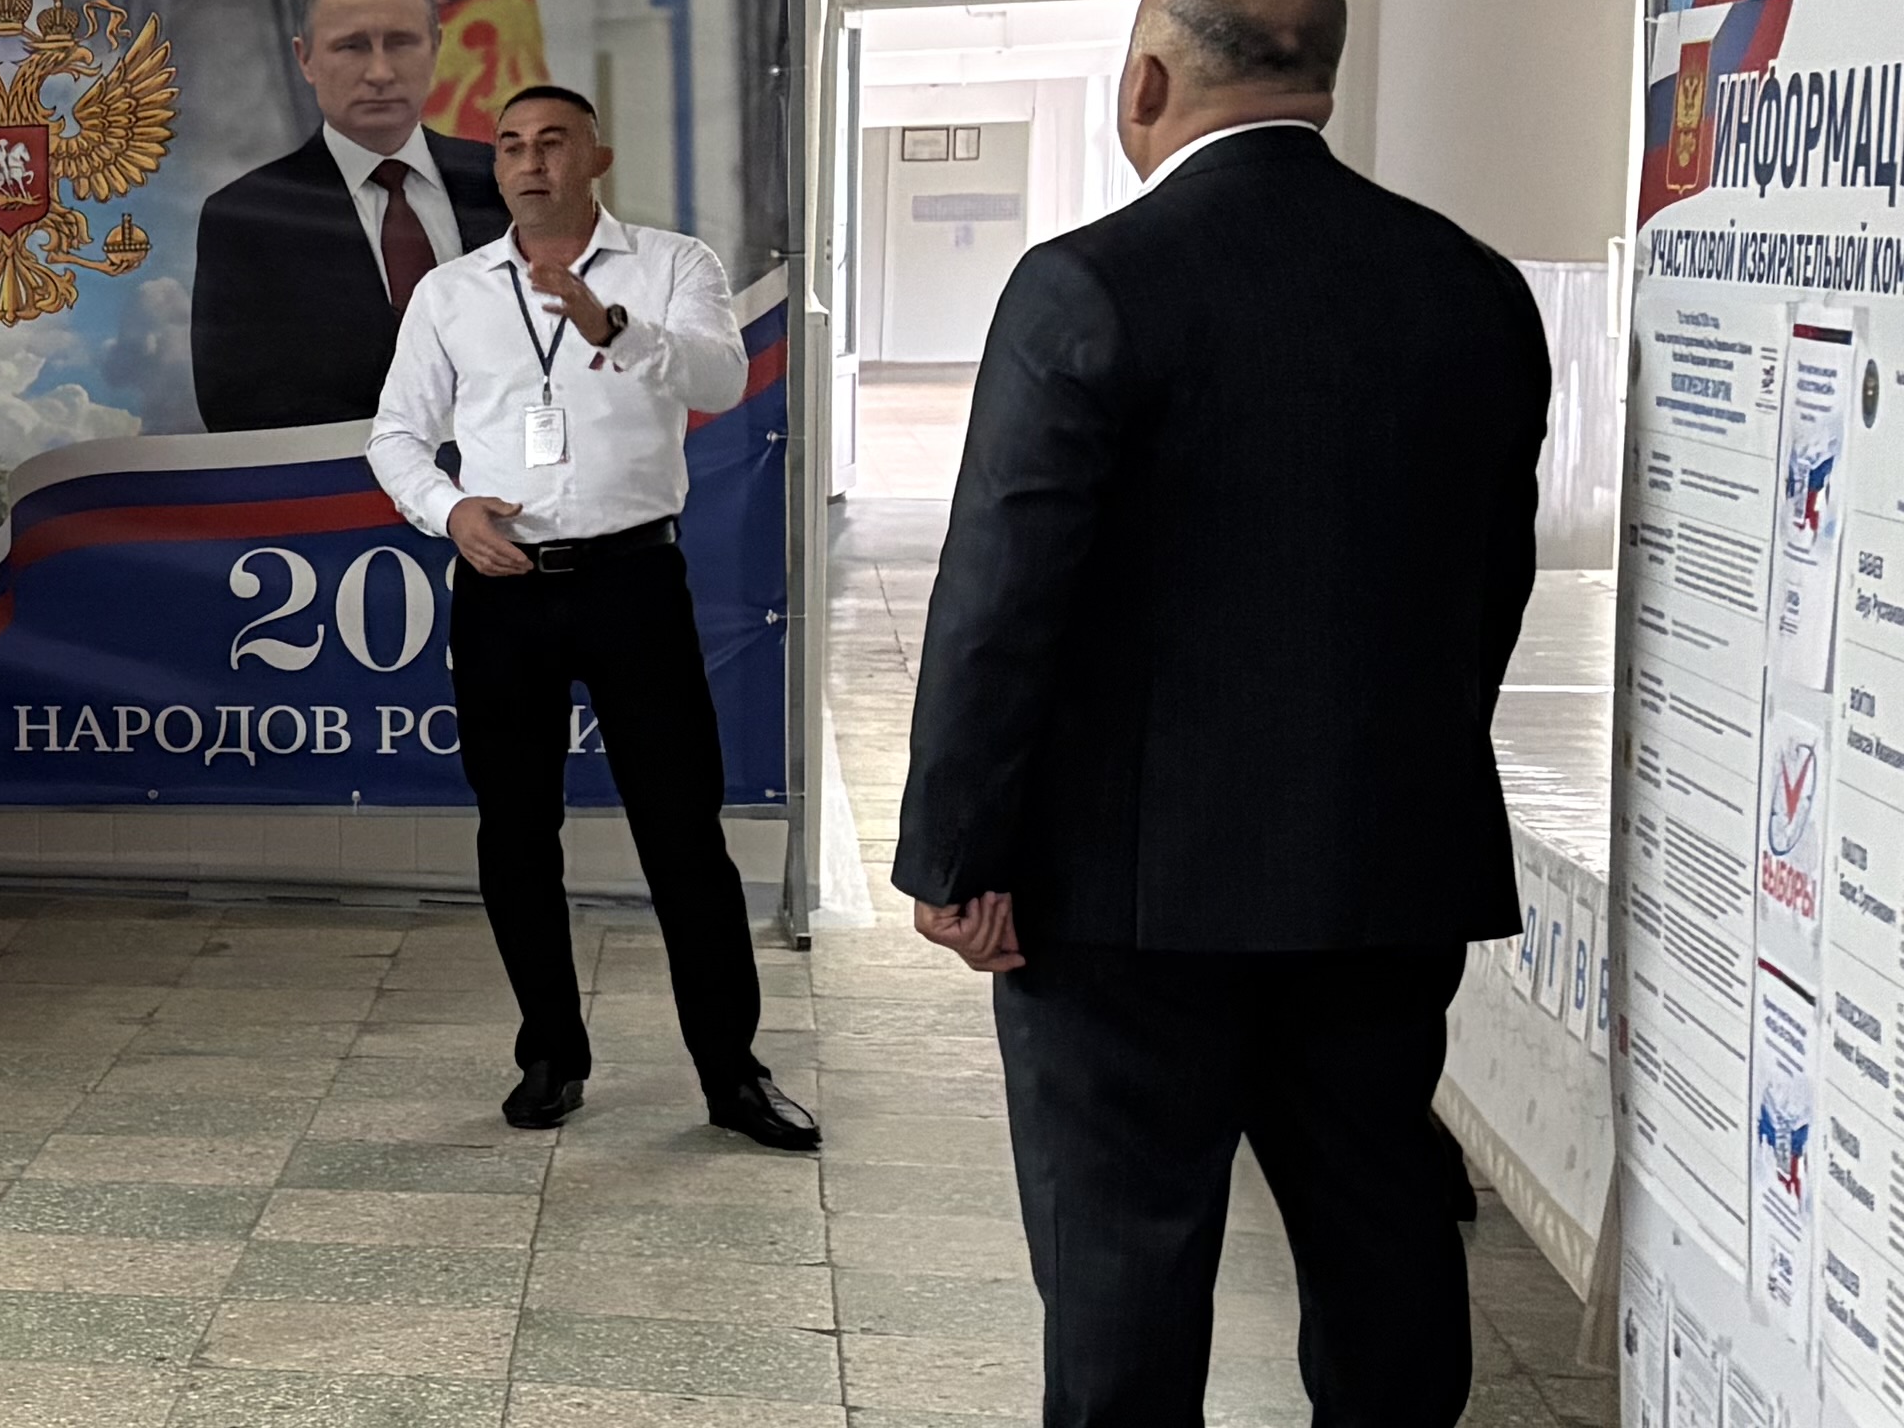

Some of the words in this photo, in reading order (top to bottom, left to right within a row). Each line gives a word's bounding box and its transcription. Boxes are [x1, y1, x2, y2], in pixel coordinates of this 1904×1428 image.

[1711, 62, 1904, 207] ИНФОРМАЦ
[1649, 218, 1736, 282] УЧАСТКОВОЙ
[1738, 221, 1869, 293] ИЗБИРАТЕЛЬНОЙ
[229, 545, 454, 673] 20
[13, 704, 352, 768] НАРОДОВ
